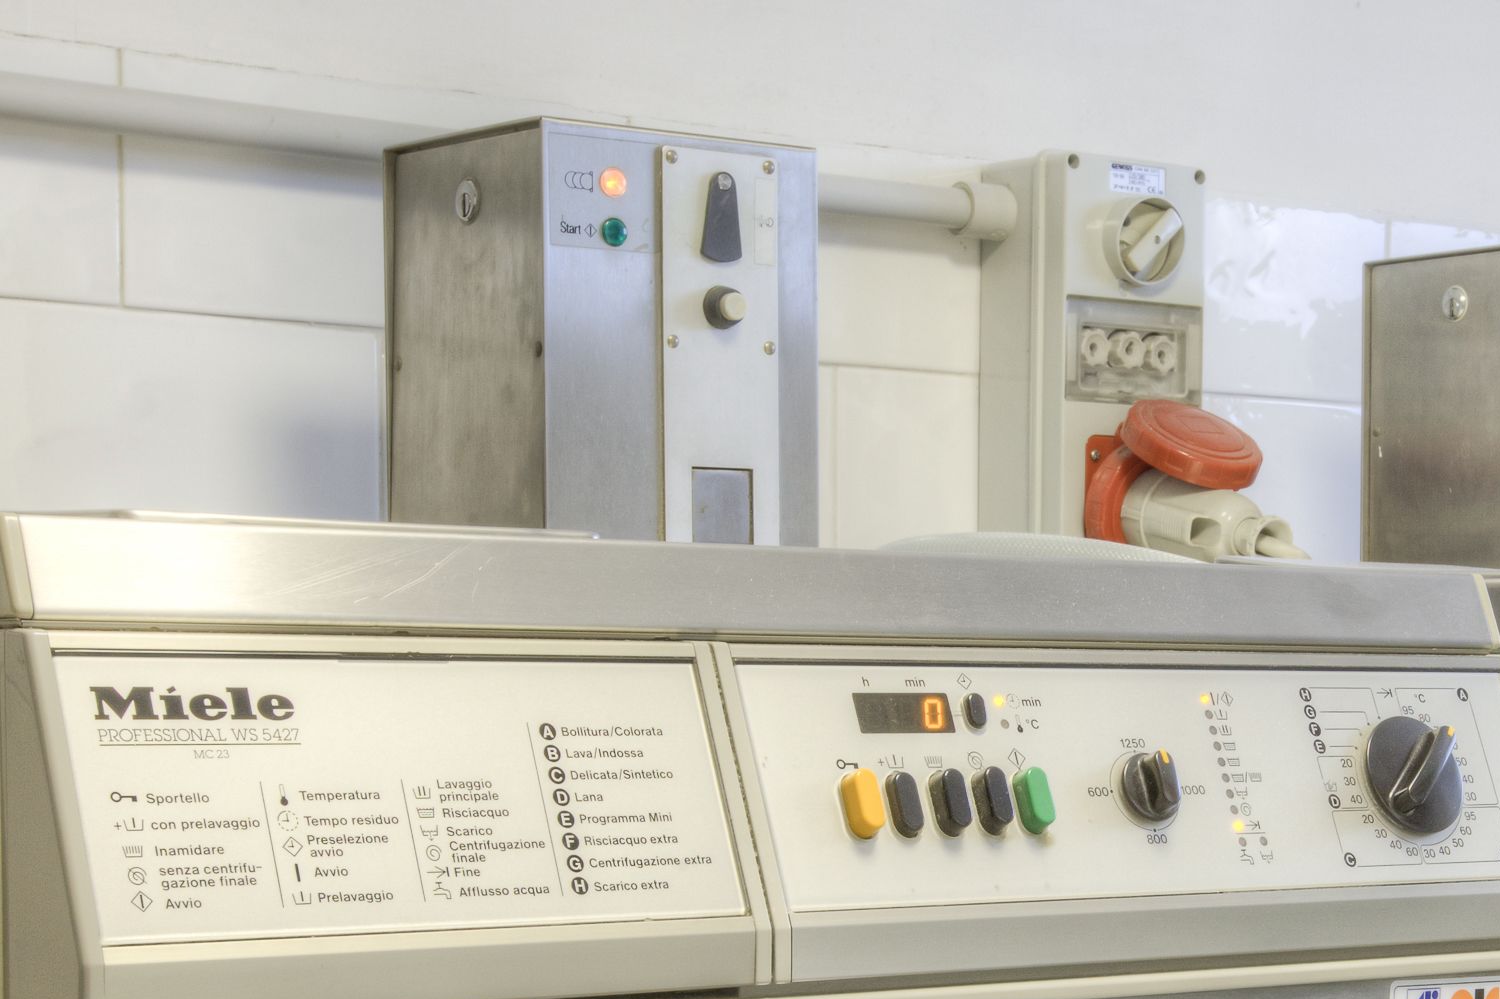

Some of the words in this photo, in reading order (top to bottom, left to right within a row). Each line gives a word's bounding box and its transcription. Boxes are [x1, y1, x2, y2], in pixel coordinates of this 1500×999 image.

[560, 220, 581, 234] Start
[862, 676, 869, 687] h
[905, 677, 926, 688] min
[1300, 688, 1311, 701] H
[1414, 693, 1426, 704] °C
[1456, 688, 1468, 701] A
[89, 686, 295, 721] Miele
[1021, 696, 1042, 707] min
[923, 697, 944, 730] 0
[1304, 705, 1316, 719] G
[1402, 706, 1415, 715] 95
[1418, 713, 1431, 723] 80
[1025, 719, 1040, 731] °C
[1309, 722, 1321, 736] F
[97, 728, 227, 743] PROFESSIONAL
[230, 728, 260, 742] WS
[262, 727, 300, 742] 5427
[540, 724, 555, 739] A
[561, 725, 664, 738] Bollitura/Colorata
[1120, 738, 1146, 749] 1250
[1314, 739, 1326, 753] E
[193, 749, 214, 760] MC
[215, 749, 230, 760] 23
[545, 746, 560, 761] B
[565, 748, 644, 760] Lava/Indossa
[1340, 758, 1353, 768] 20
[1455, 757, 1468, 767] 50
[550, 768, 564, 783] C
[570, 769, 674, 781] Delicata/Sintetico
[1344, 776, 1356, 786] 30
[1462, 775, 1474, 784] 40
[436, 779, 492, 791] Lavaggio
[1181, 785, 1206, 796] 1000
[299, 790, 380, 803] Temperatura
[440, 791, 499, 803] principale
[554, 789, 569, 805] D
[574, 792, 604, 803] Lana
[1087, 786, 1109, 797] 600
[1465, 792, 1477, 801] 30
[146, 792, 210, 805] Sportello
[1329, 795, 1340, 808] D
[1350, 794, 1363, 804] 40
[442, 807, 510, 819] Risciacquo
[1362, 814, 1375, 824] 20
[1464, 811, 1476, 821] 95
[150, 820, 177, 831] con
[180, 817, 260, 831] prelavaggio
[303, 815, 348, 828] Tempo
[351, 814, 399, 826] residuo
[559, 812, 573, 827] E
[579, 813, 644, 826] Programma
[647, 812, 673, 823] Mini
[446, 826, 493, 837] Scarico
[1375, 829, 1388, 839] 30
[1459, 826, 1472, 836] 60
[306, 833, 389, 846] Preselezione
[450, 838, 546, 851] Centrifugazione
[563, 834, 578, 849] F
[583, 835, 647, 848] Risciacquo
[651, 835, 678, 845] extra
[1147, 834, 1168, 845] 800
[1389, 840, 1402, 850] 40
[1452, 838, 1464, 848] 50
[154, 844, 225, 857] Inamidare
[310, 847, 344, 858] avvio
[1406, 847, 1418, 857] 60
[1423, 849, 1436, 858] 30
[1438, 846, 1451, 855] 40
[452, 852, 486, 863] finale
[568, 856, 583, 871] G
[589, 855, 680, 869] Centrifugazione
[684, 855, 712, 865] extra
[1344, 853, 1356, 867] C
[159, 866, 200, 876] senza
[203, 863, 263, 875] centrifu-
[314, 866, 349, 878] Avvio
[454, 867, 481, 878] Fine
[161, 877, 215, 891] gazione
[219, 875, 257, 887] finale
[573, 878, 587, 894] H
[594, 880, 638, 892] Scarico
[641, 880, 669, 890] extra
[317, 890, 394, 903] Prelavaggio
[459, 886, 510, 898] Afflusso
[513, 885, 550, 897] acqua
[165, 897, 202, 910] Avvio
